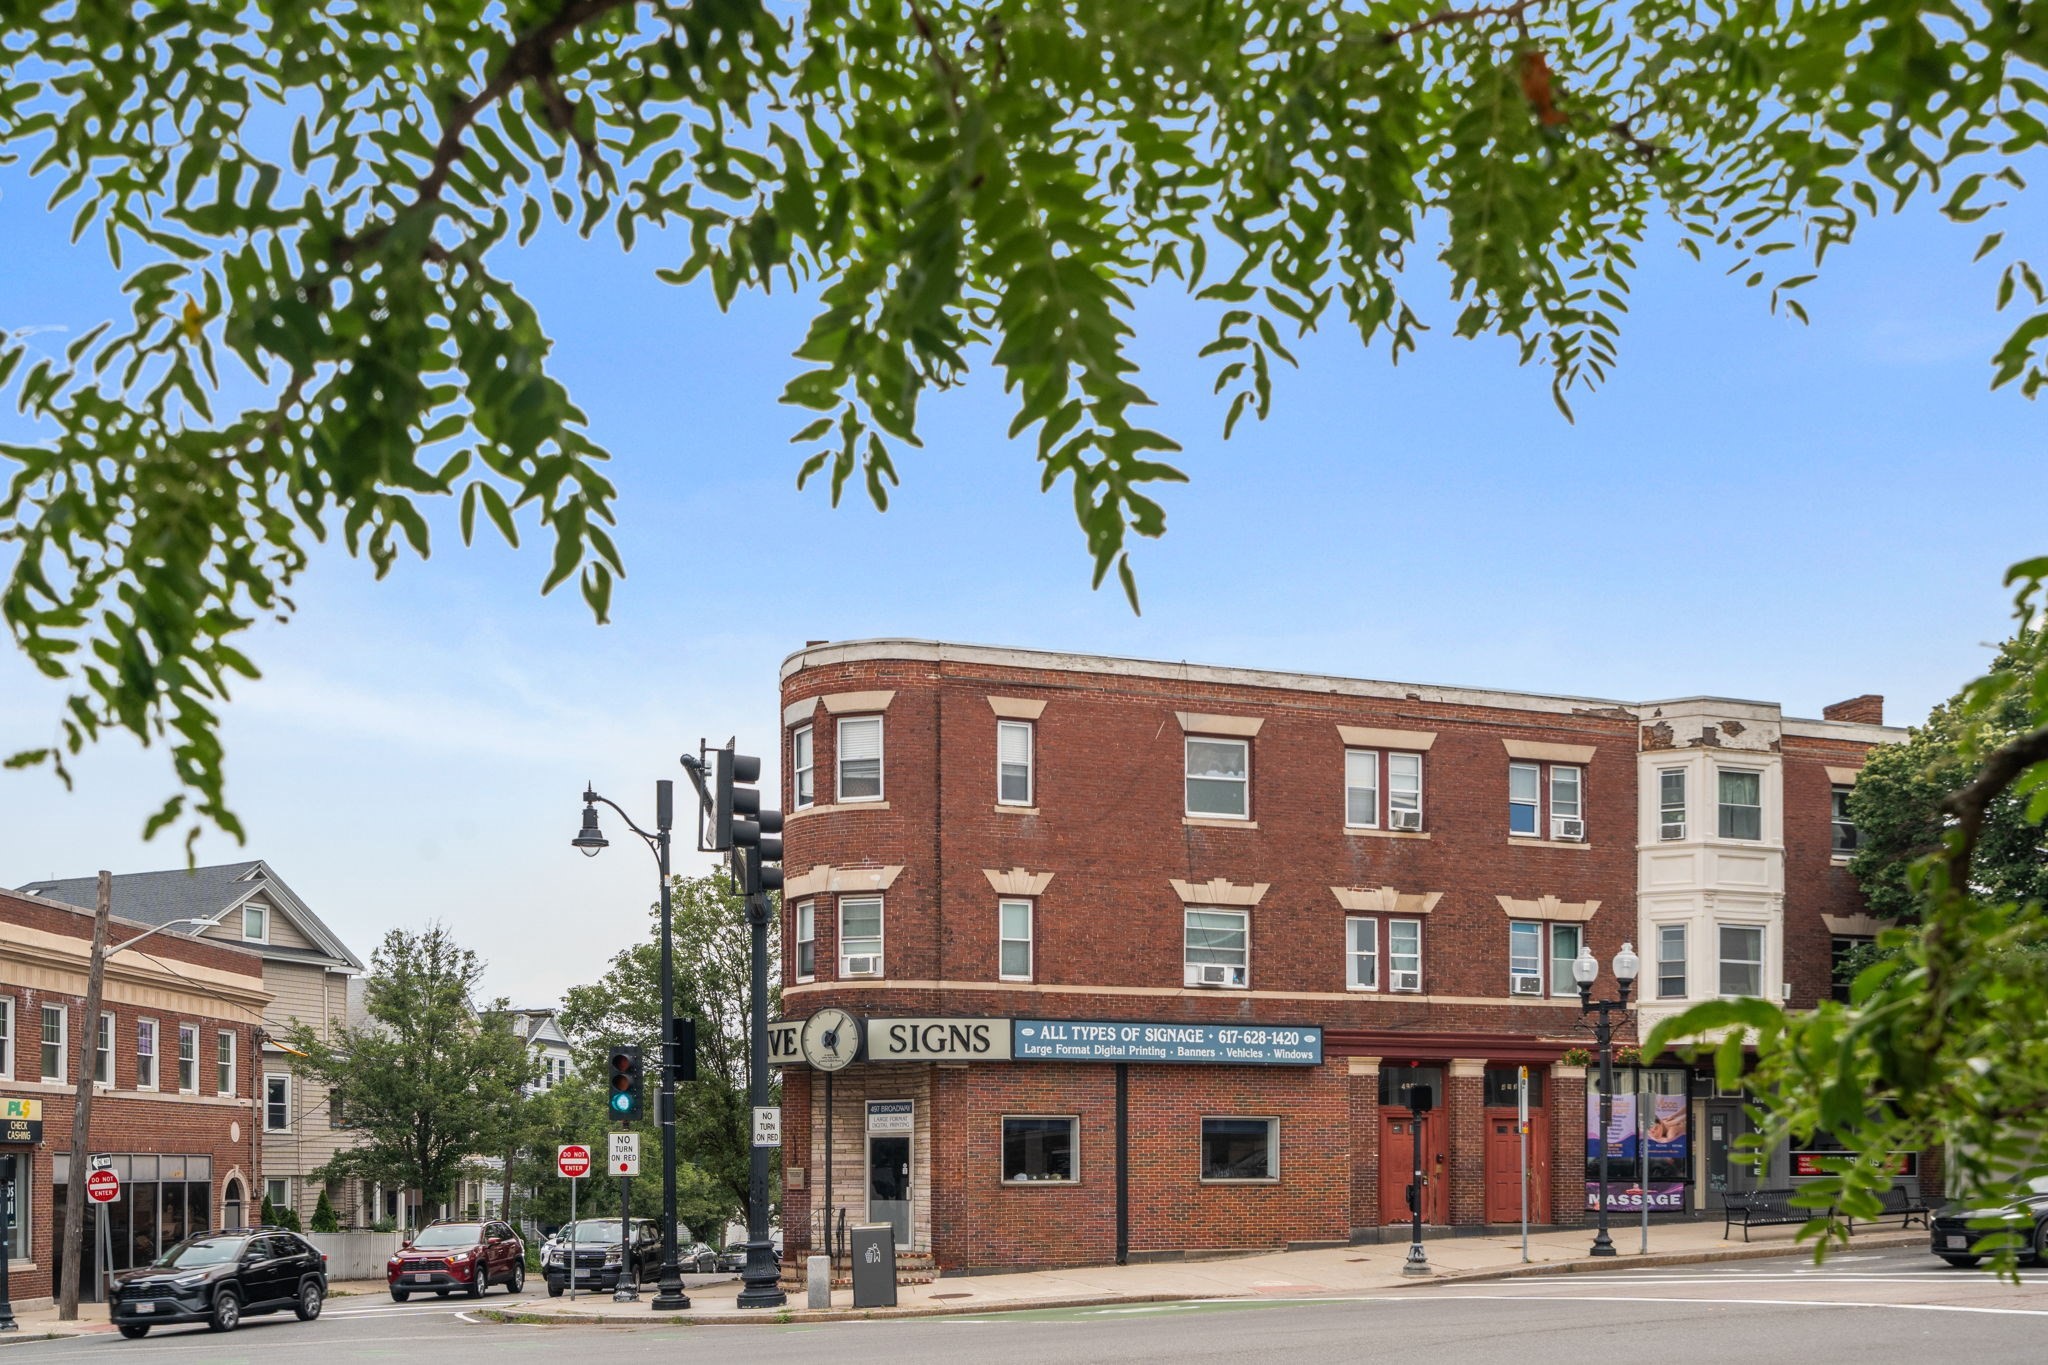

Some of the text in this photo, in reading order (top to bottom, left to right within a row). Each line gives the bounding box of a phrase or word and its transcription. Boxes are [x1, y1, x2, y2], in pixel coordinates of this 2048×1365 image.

[889, 1024, 991, 1053] SIGNS
[1040, 1025, 1299, 1045] ALL TYPES OF SIGNAGE 617-628-1420
[1024, 1043, 1313, 1059] Large Format Digital Printing Banners Vehicles Windows
[881, 1104, 911, 1113] BROADWAY
[762, 1112, 773, 1120] NO
[11, 1121, 28, 1130] CHECK
[760, 1122, 775, 1130] TURN
[8, 1131, 31, 1140] CASHING
[617, 1135, 631, 1144] NO
[756, 1133, 778, 1141] ON RED
[623, 1154, 637, 1162] RED
[1588, 1194, 1681, 1206] MASSAGE
